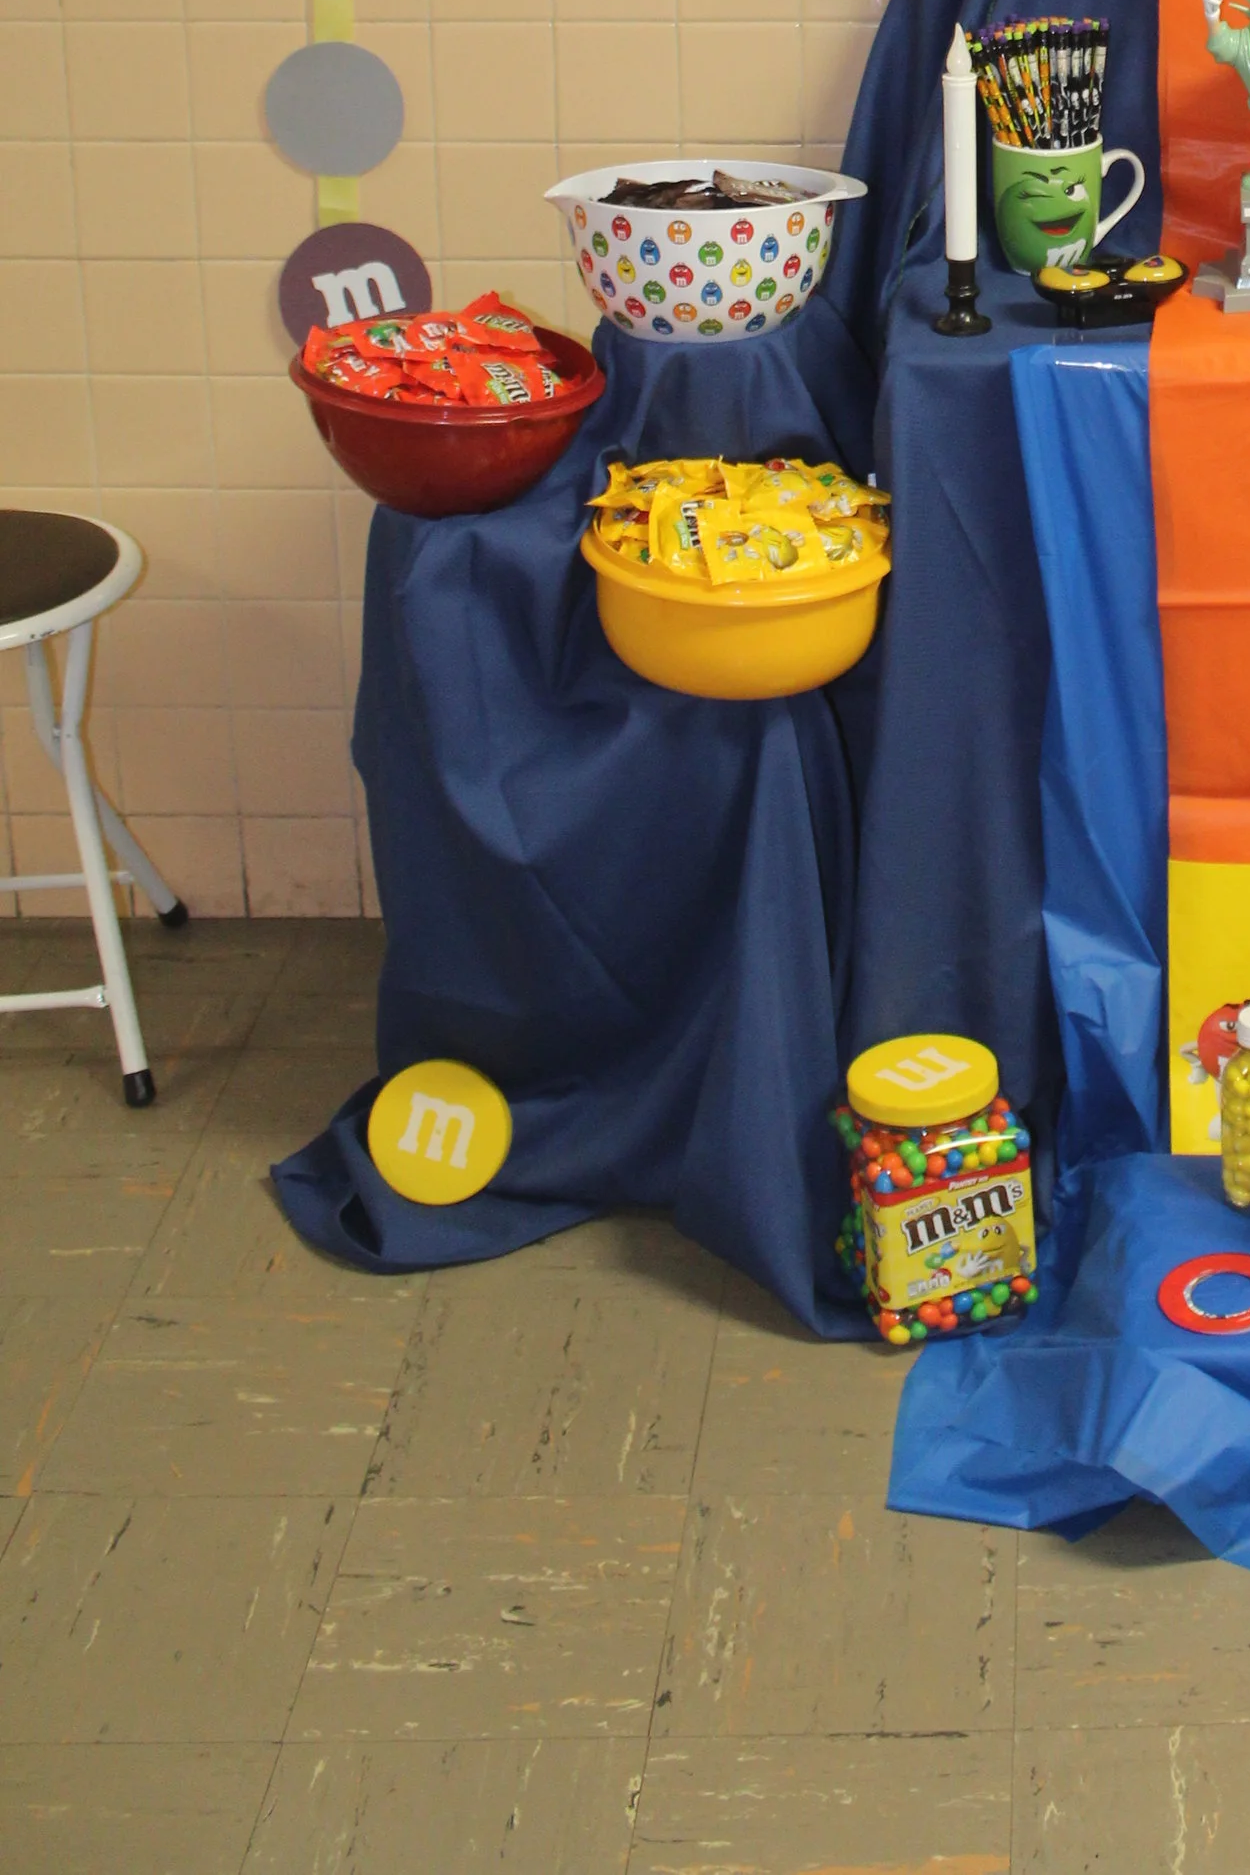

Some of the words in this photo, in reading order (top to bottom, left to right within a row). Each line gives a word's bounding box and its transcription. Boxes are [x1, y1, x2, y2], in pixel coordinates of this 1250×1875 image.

[1046, 238, 1087, 267] m
[312, 262, 406, 328] m
[875, 1046, 972, 1092] m
[398, 1091, 476, 1169] m
[903, 1183, 1024, 1251] m&m's
